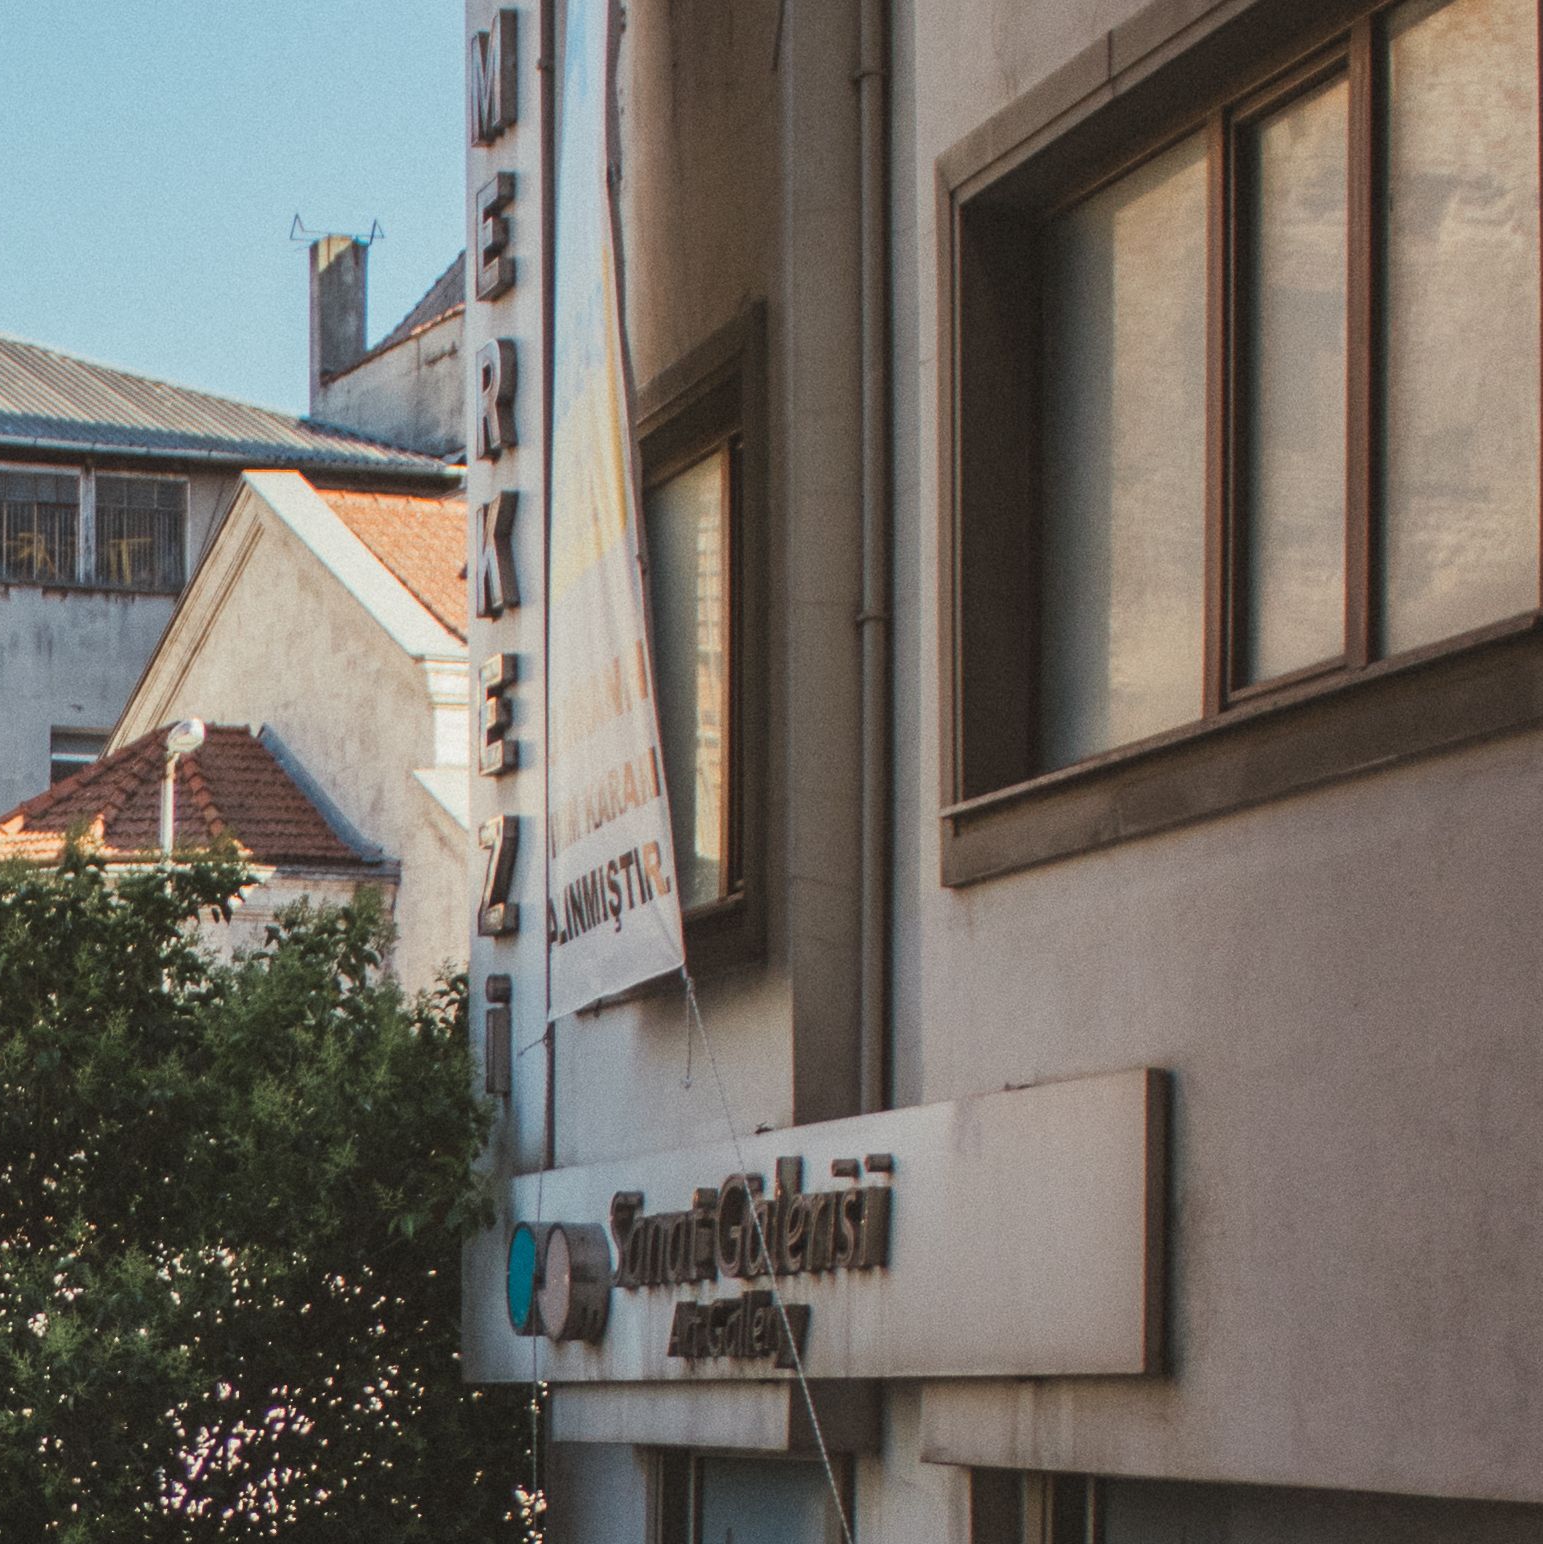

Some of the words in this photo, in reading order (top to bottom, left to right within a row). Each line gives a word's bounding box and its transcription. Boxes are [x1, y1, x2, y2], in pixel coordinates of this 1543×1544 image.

[610, 1188, 718, 1288] Sanat
[716, 1153, 894, 1279] Galerisi
[667, 1300, 708, 1358] Art
